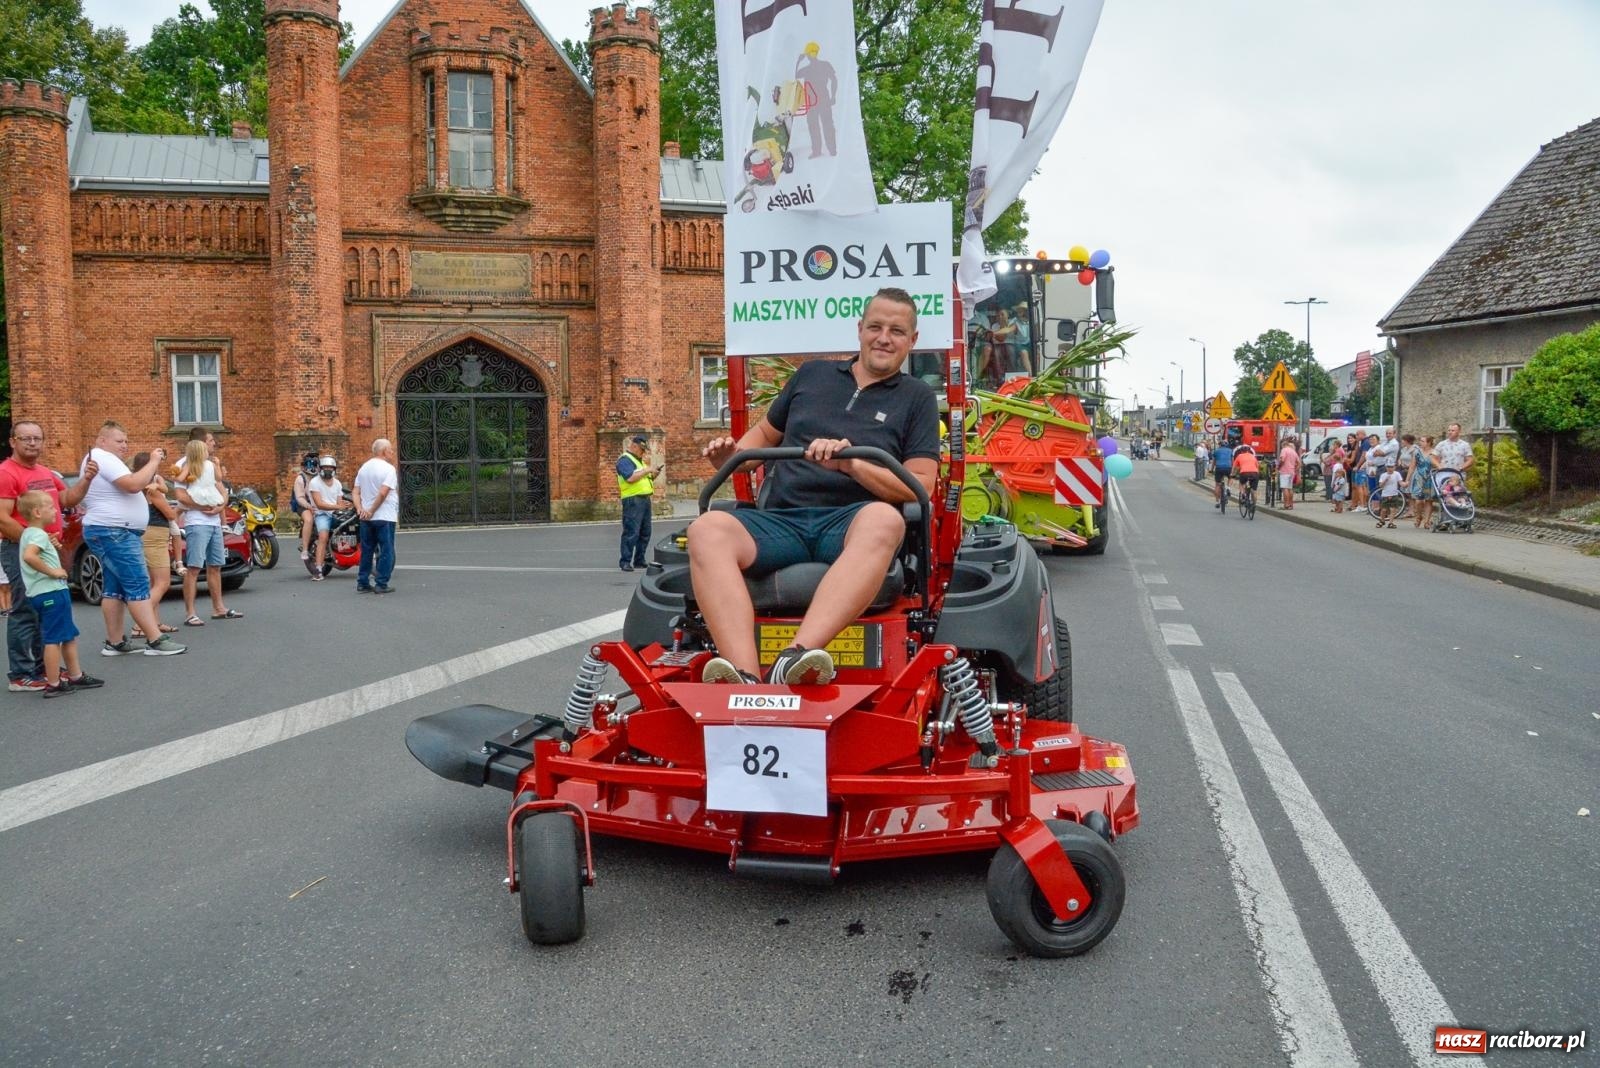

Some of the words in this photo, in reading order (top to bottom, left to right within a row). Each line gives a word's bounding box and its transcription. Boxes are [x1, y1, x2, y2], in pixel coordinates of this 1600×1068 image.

[739, 242, 937, 284] PROSAT
[733, 298, 818, 322] MASZYNY
[734, 696, 797, 708] PROSAT
[743, 743, 788, 779] 82.
